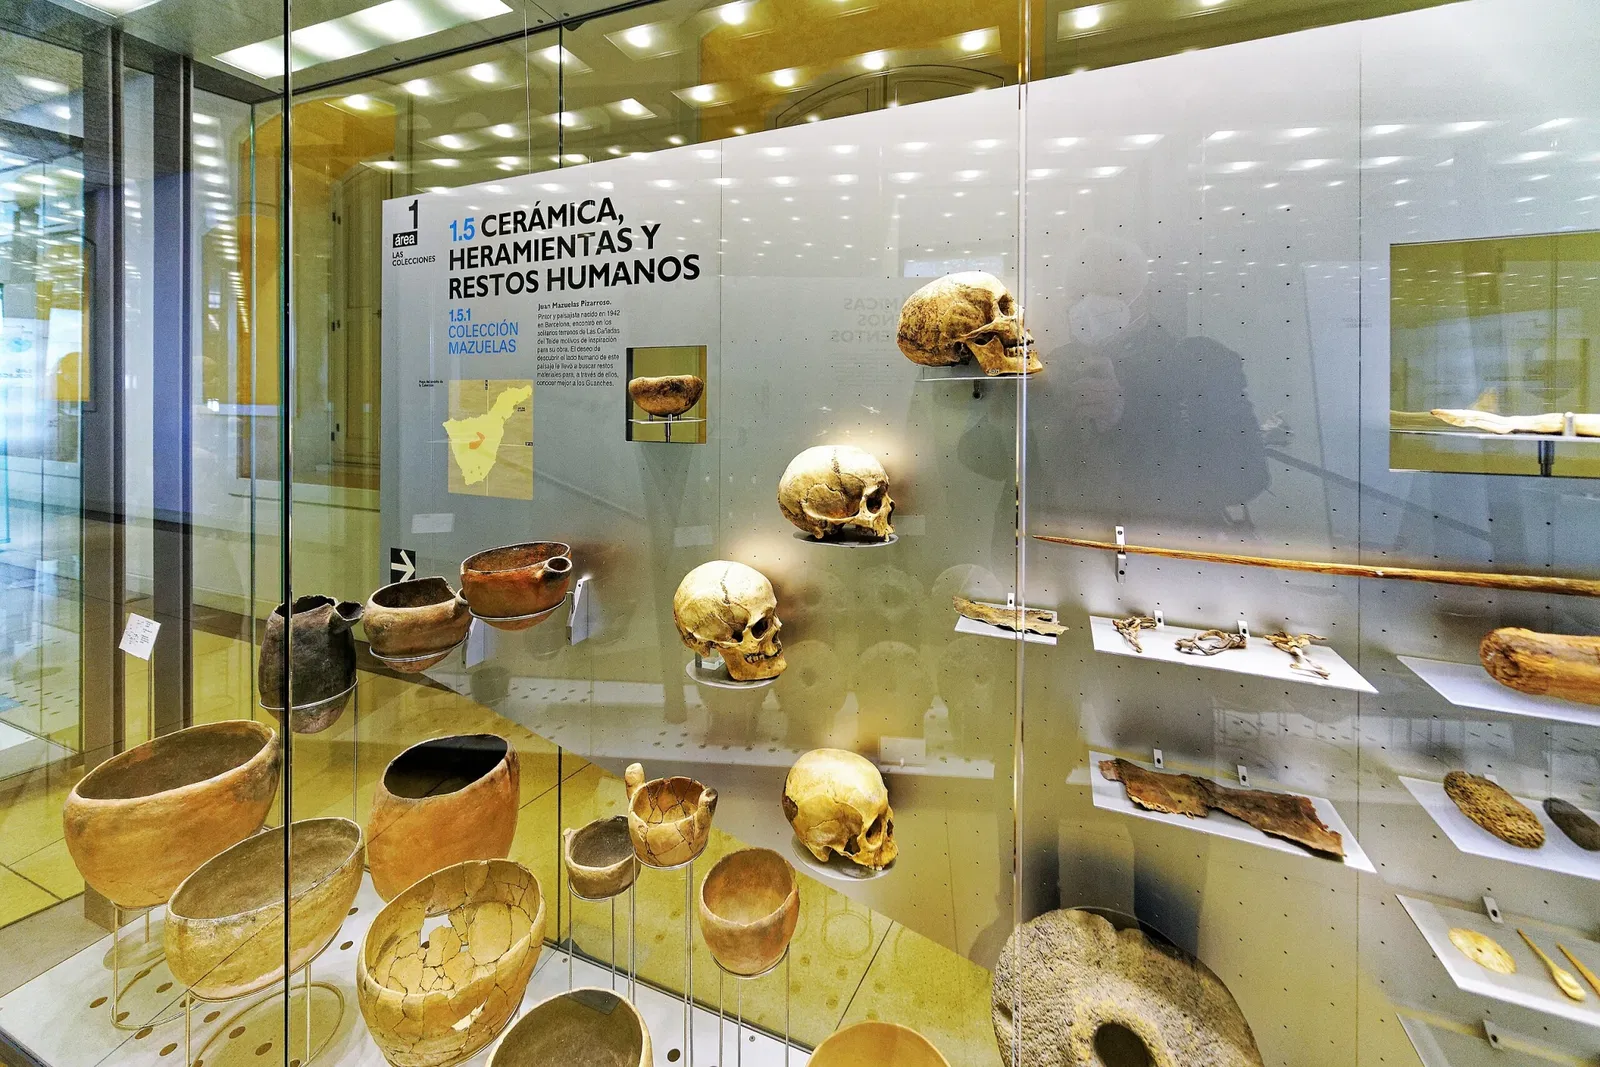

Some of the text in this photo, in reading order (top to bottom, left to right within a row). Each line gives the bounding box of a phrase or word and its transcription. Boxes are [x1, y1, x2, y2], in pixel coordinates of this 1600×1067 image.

[409, 200, 418, 229] 1
[449, 197, 624, 242] 1.5 CERÁMICA,
[395, 234, 415, 247] área
[449, 223, 662, 271] HERAMIENTAS Y
[392, 250, 404, 259] LAS
[392, 255, 436, 267] COLECCIONES
[449, 254, 700, 300] RESTOS HUMANOS
[538, 303, 551, 311] Juan
[449, 308, 471, 321] 1.5.1
[556, 312, 580, 320] paisajista
[448, 319, 518, 338] COLECCIÓN
[597, 327, 620, 335] Cañadas
[588, 336, 617, 344] inspiración
[448, 339, 516, 354] MAZUELAS
[537, 363, 555, 371] paisaje
[557, 380, 571, 388] mejor
